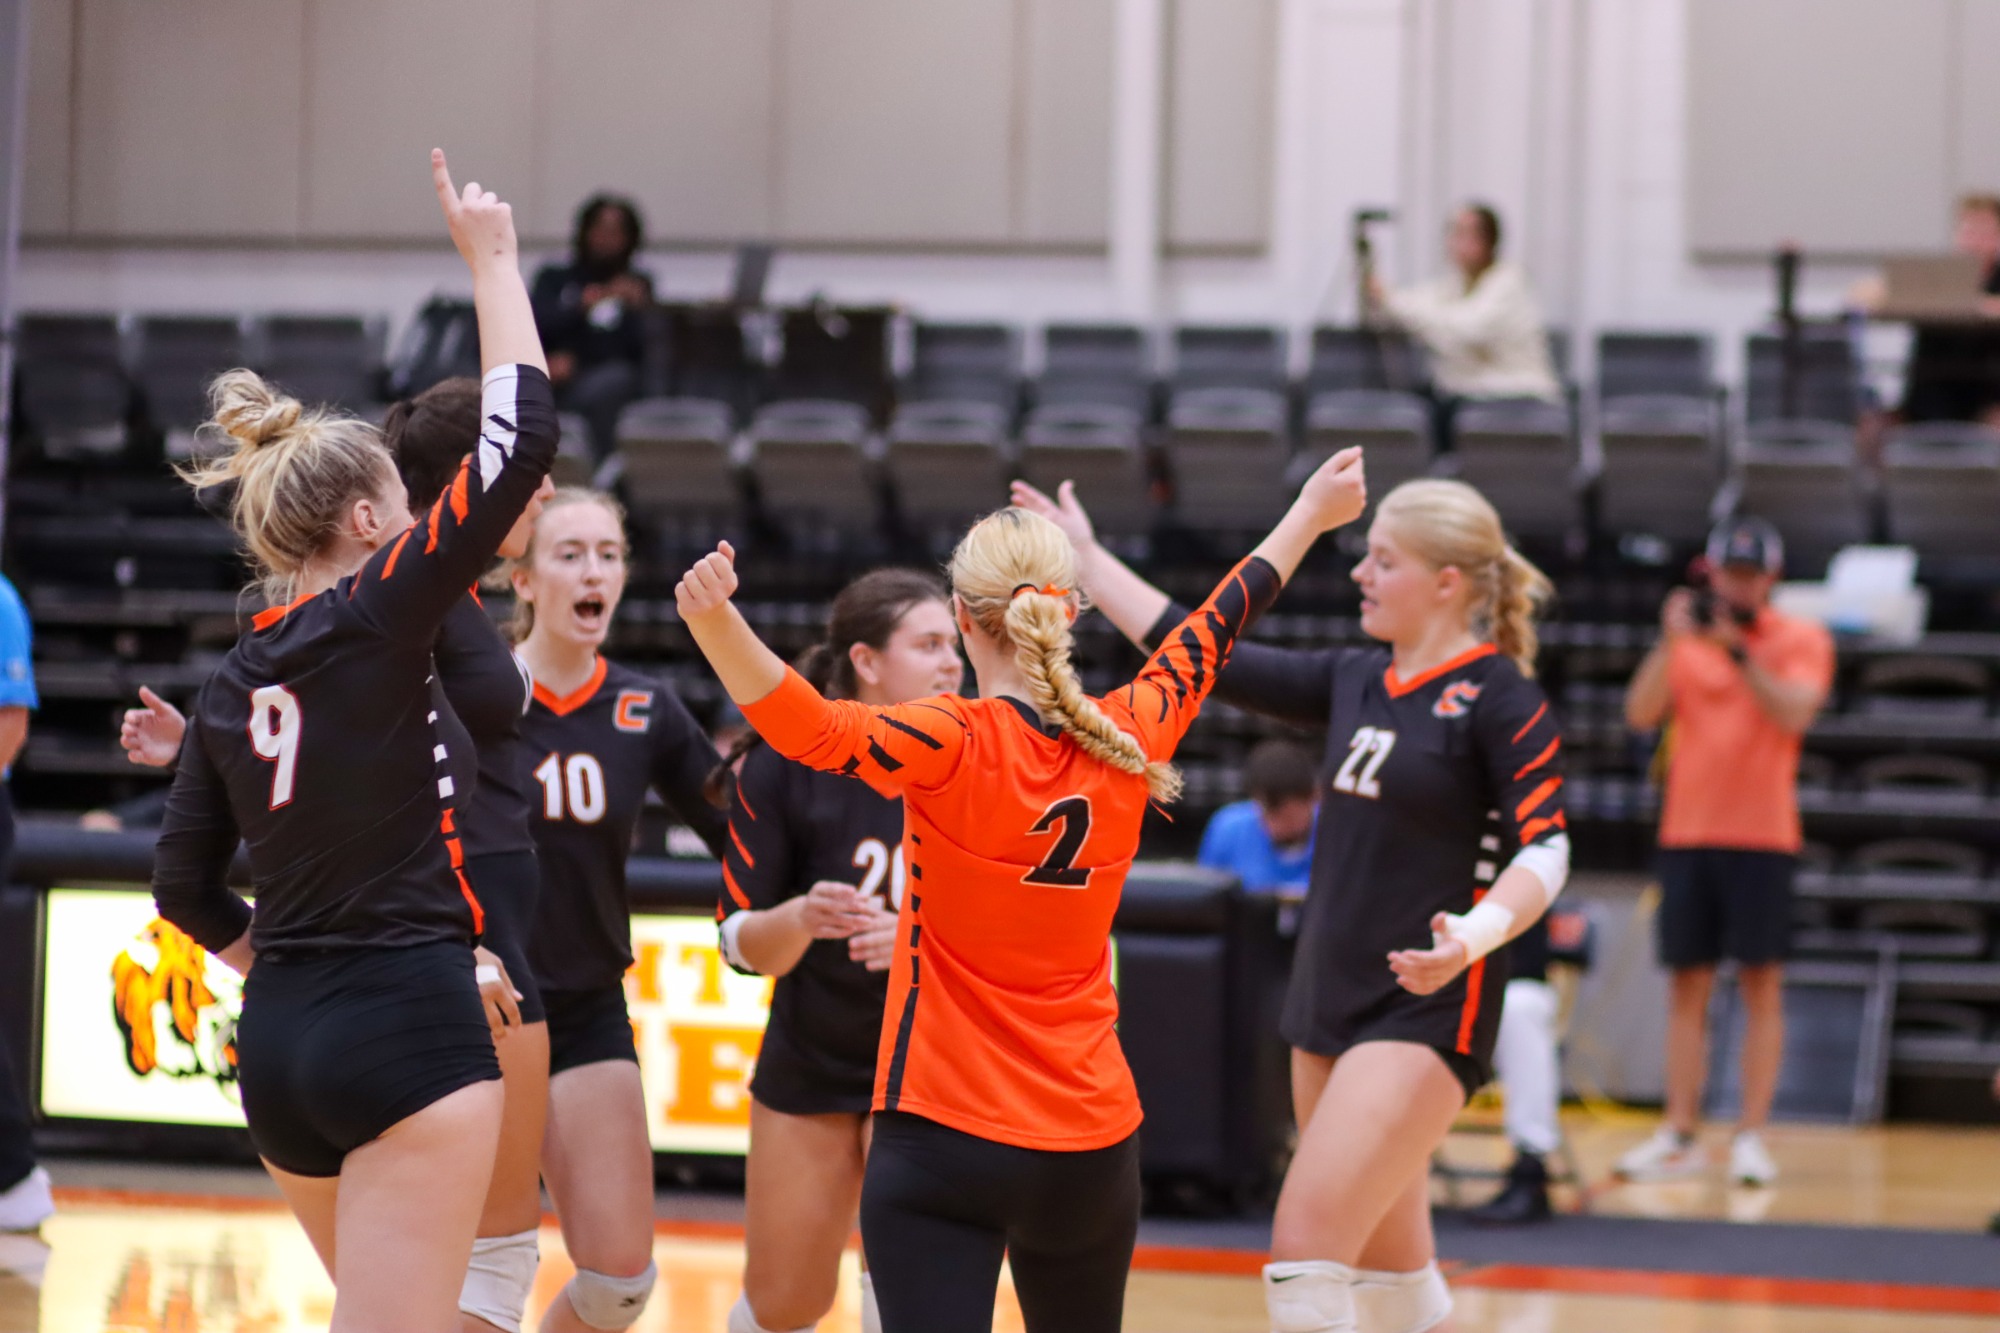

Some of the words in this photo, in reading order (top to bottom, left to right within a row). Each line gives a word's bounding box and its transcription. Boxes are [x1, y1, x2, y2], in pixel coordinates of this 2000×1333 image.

[247, 683, 303, 811] 9
[613, 688, 653, 732] C
[533, 752, 607, 824] 10
[1333, 725, 1396, 799] 22
[1020, 794, 1092, 889] 2
